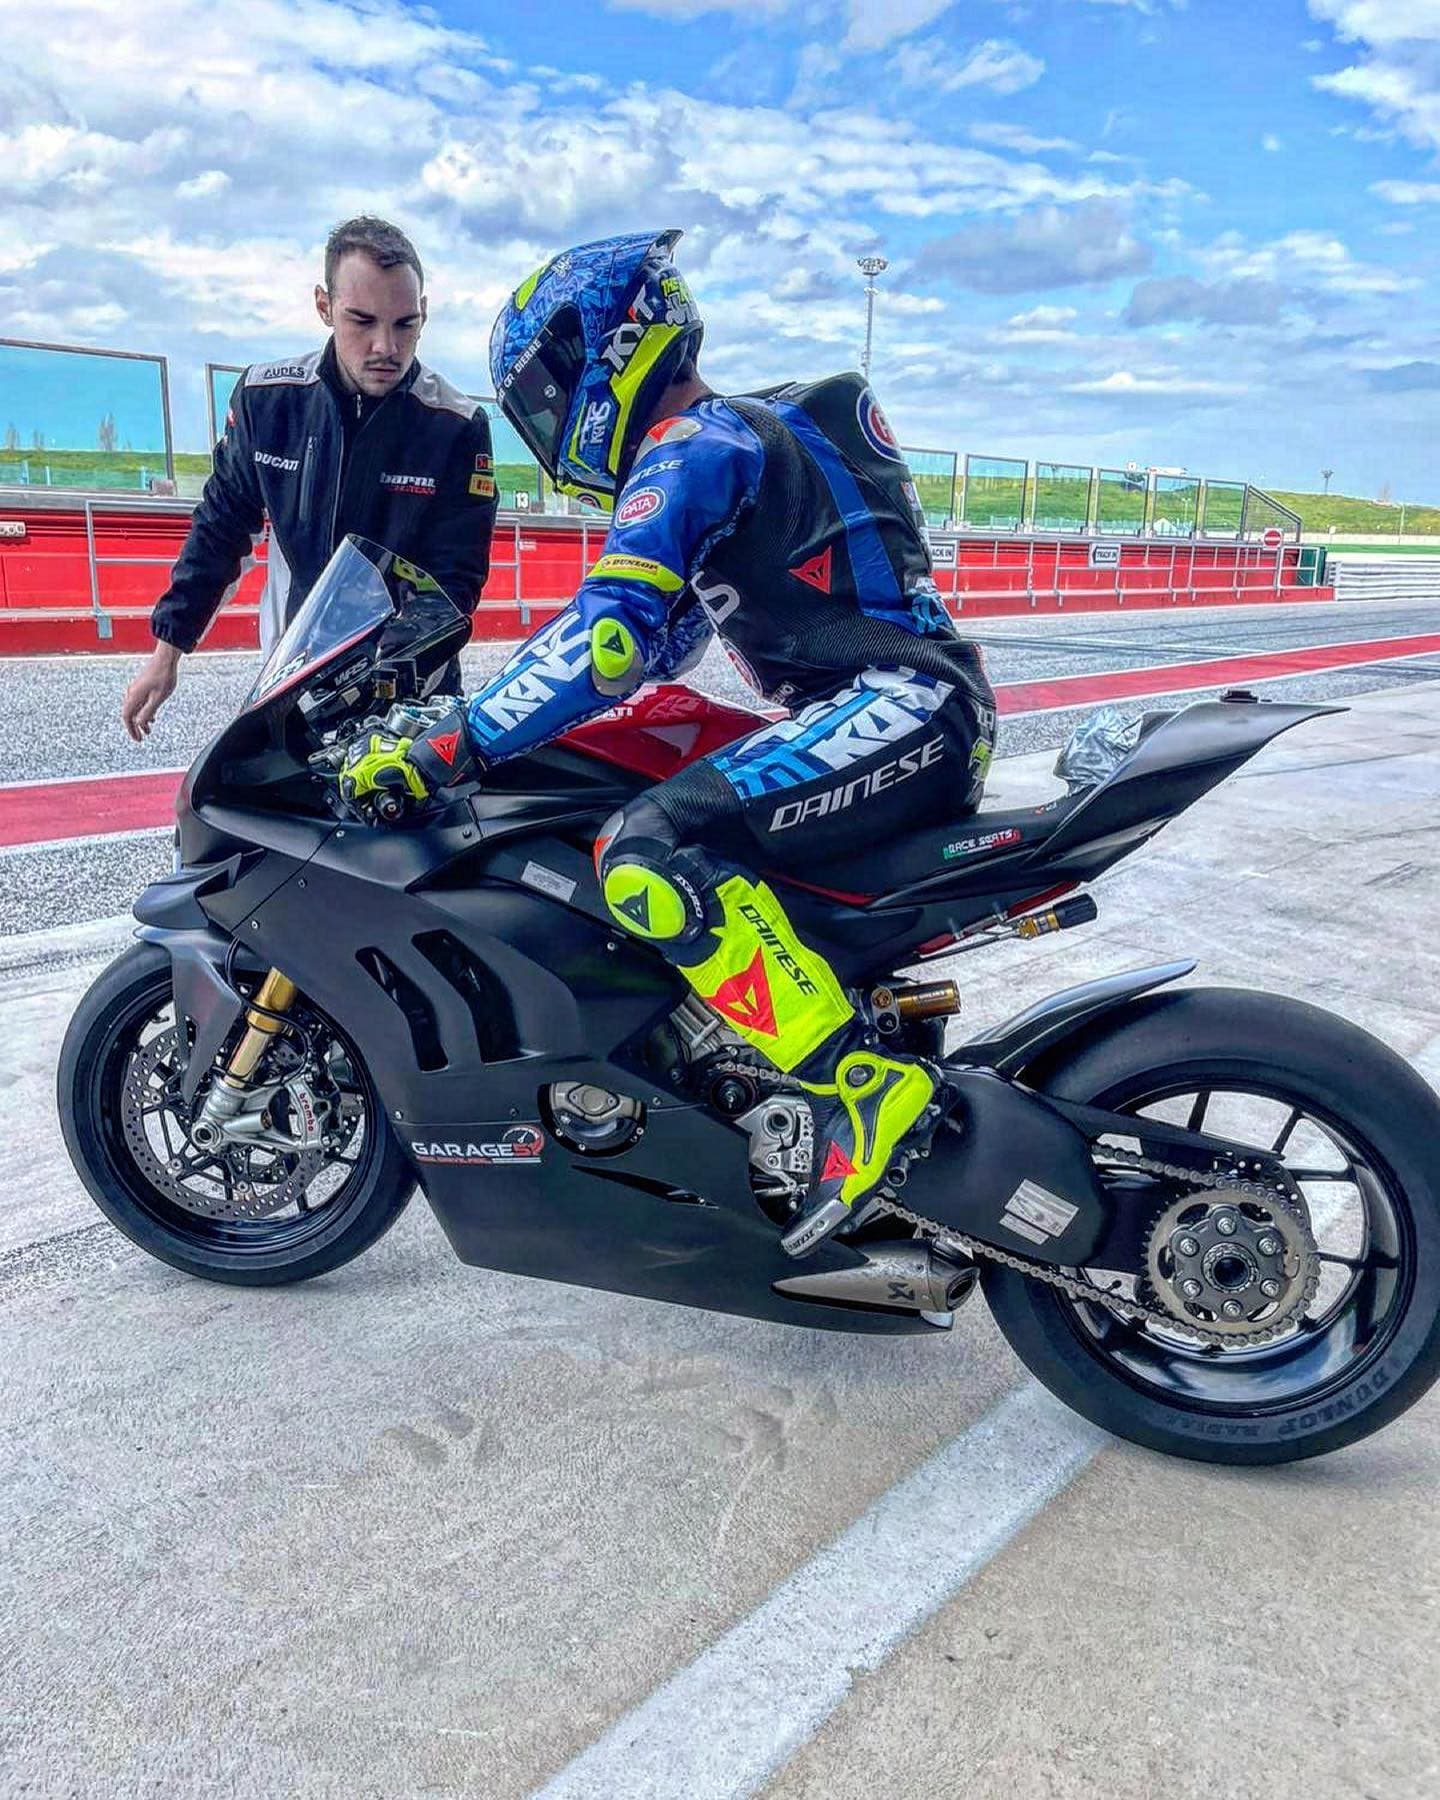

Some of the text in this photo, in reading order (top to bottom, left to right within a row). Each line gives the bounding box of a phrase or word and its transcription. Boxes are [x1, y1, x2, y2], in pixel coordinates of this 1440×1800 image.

[254, 451, 300, 471] DUCATI
[516, 492, 529, 509] 13
[622, 498, 653, 517] PATA
[612, 558, 659, 571] DUNLOP
[768, 733, 945, 832] DAINESE
[948, 840, 976, 854] RACE
[738, 904, 819, 996] DAINESE
[299, 1092, 315, 1132] brembo
[1278, 1370, 1391, 1440] DUNLOP
